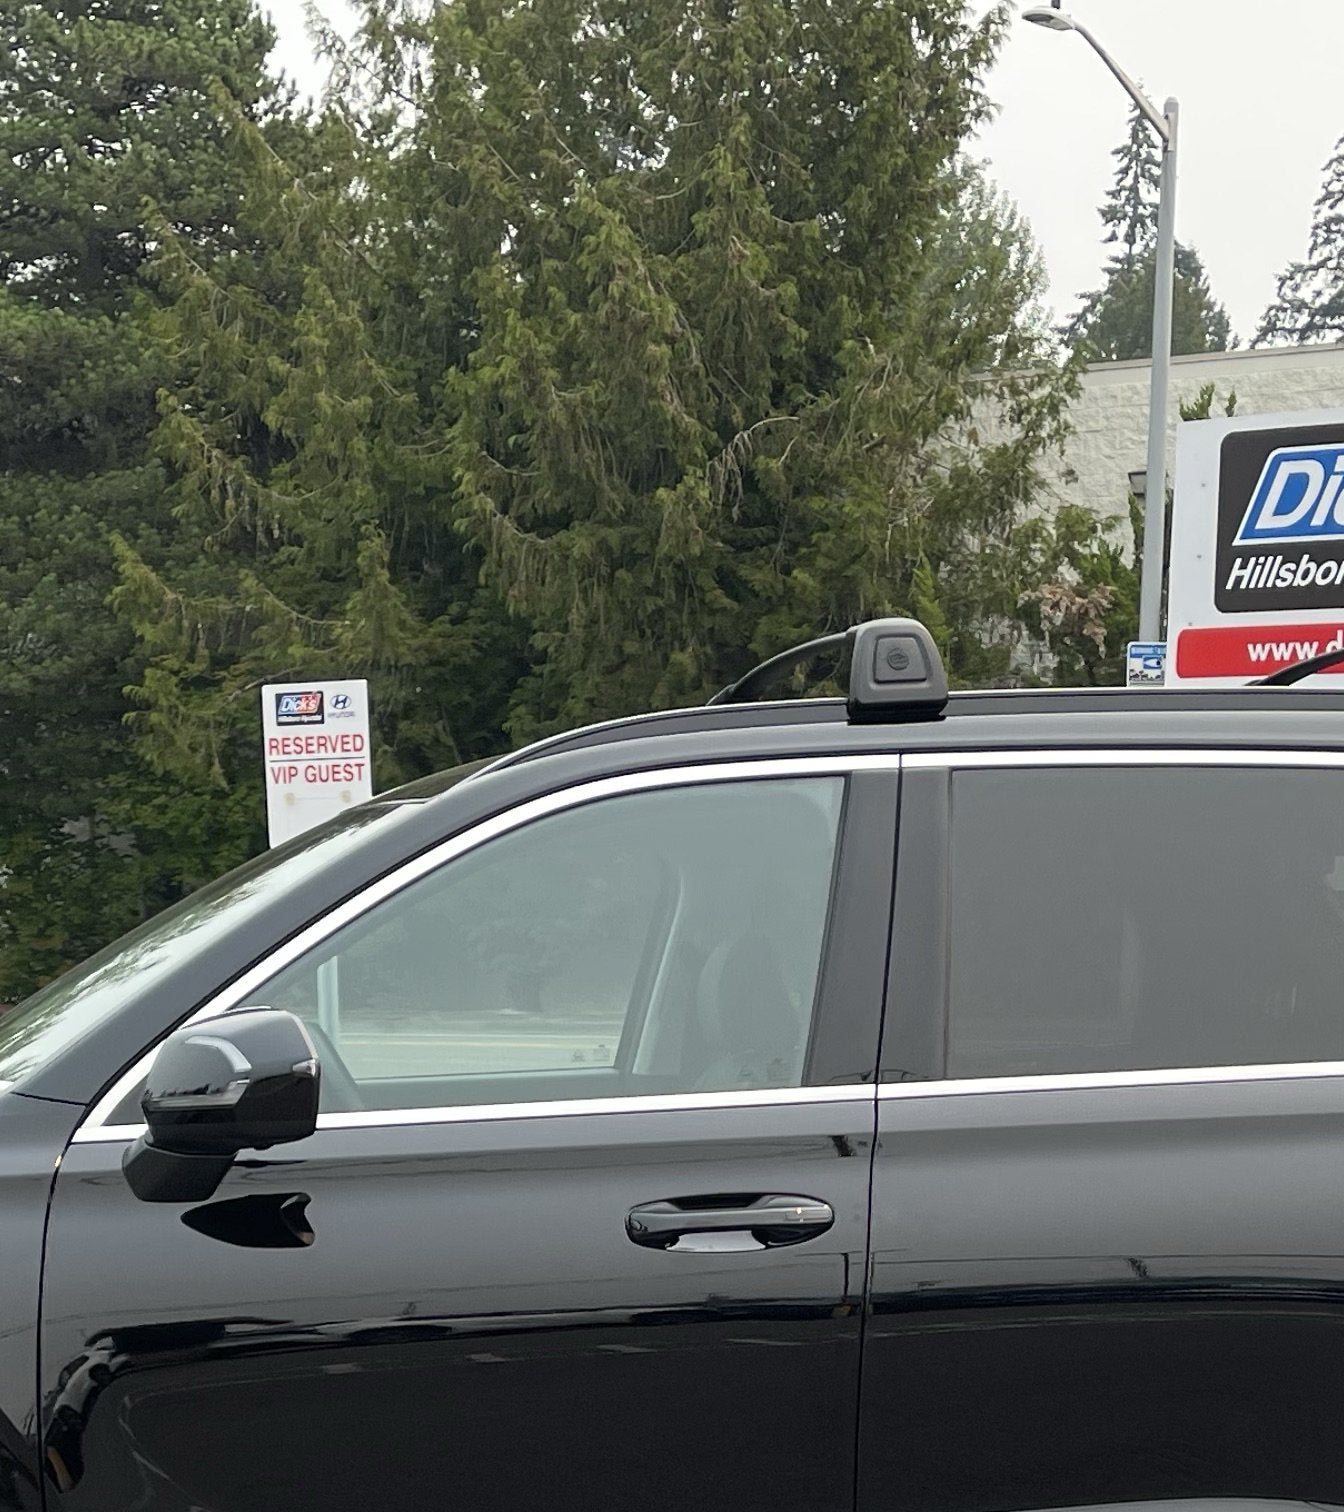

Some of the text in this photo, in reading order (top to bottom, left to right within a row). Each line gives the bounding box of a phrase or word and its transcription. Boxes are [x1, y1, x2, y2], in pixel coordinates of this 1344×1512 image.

[269, 733, 365, 756] RESERVED
[271, 763, 365, 784] VIP GUEST
